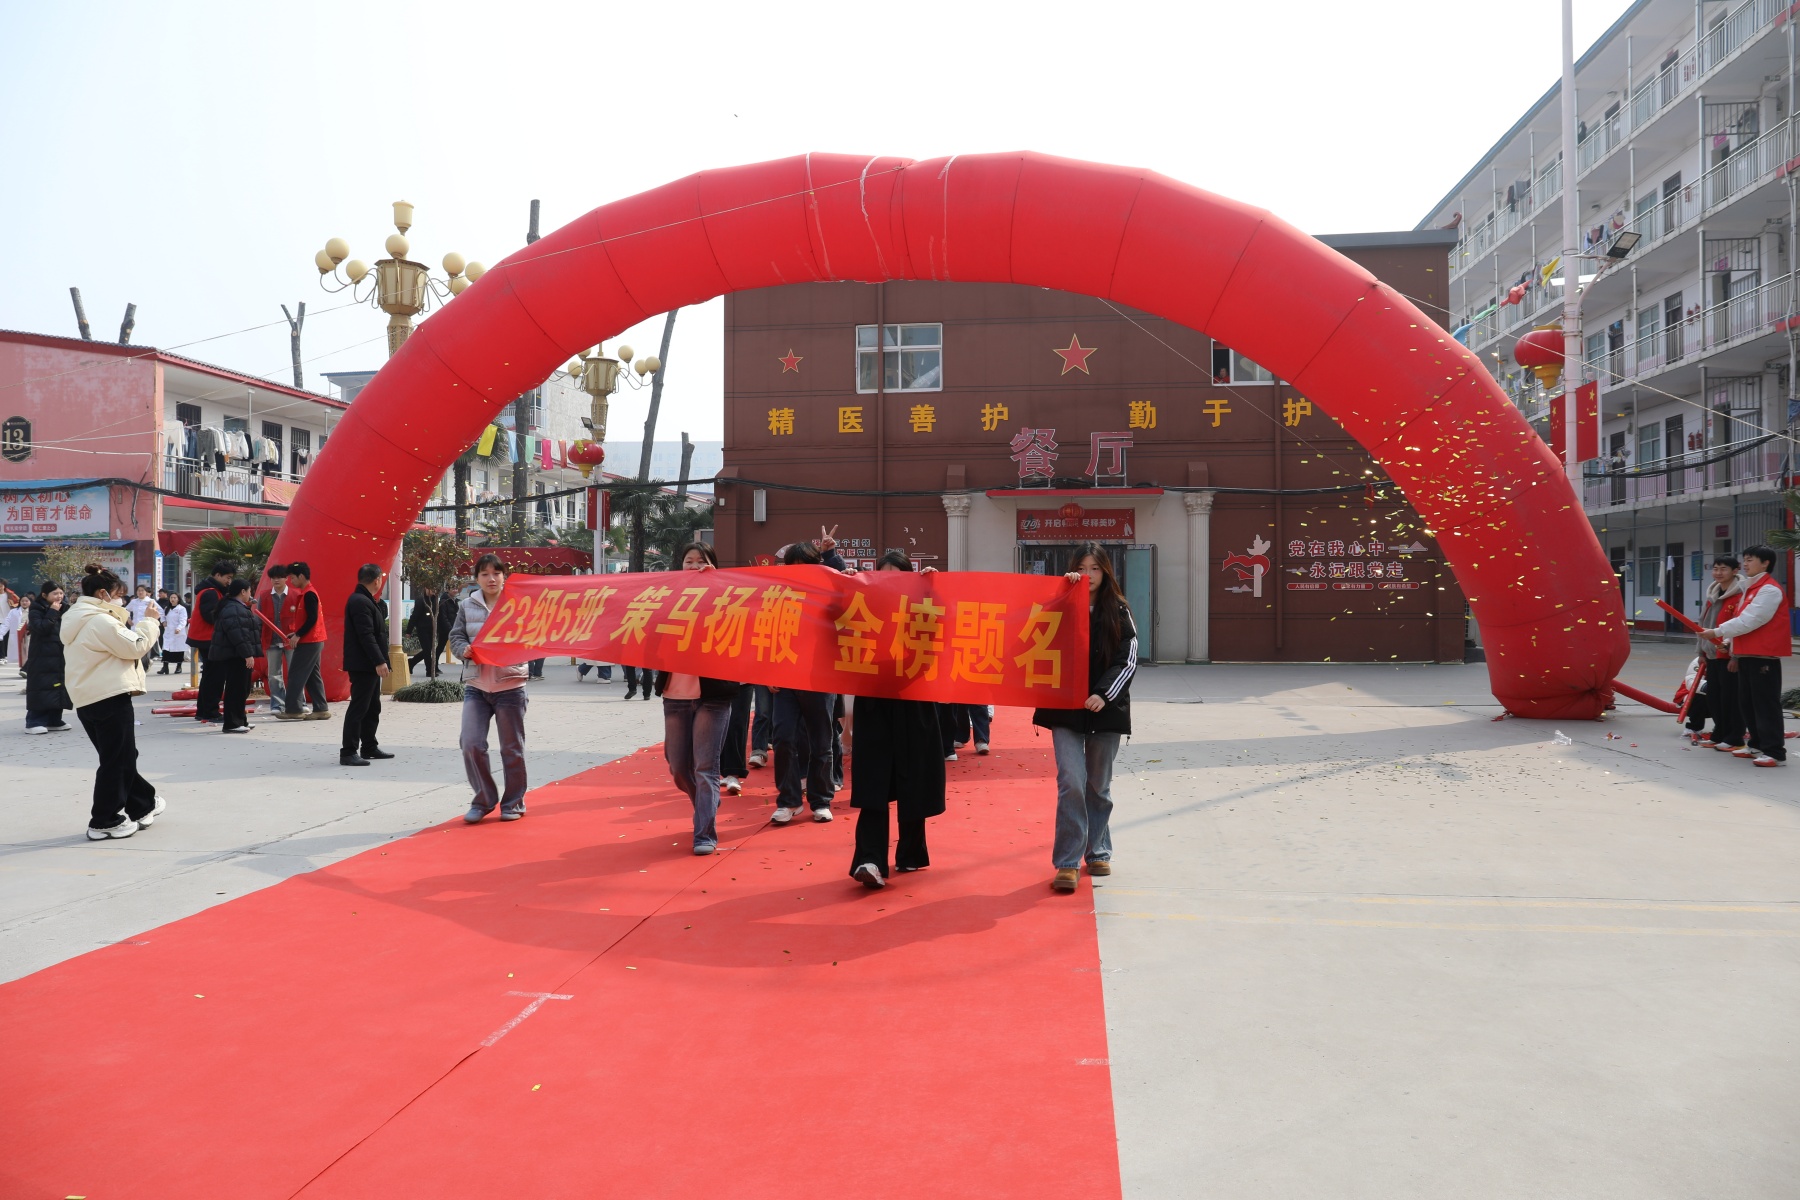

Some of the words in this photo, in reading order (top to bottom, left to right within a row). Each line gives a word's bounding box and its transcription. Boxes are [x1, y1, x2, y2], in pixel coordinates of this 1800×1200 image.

[767, 402, 1010, 436] 精医善护
[1011, 427, 1133, 479] 餐厅
[6, 504, 92, 521] 为国育才使命
[1288, 539, 1385, 557] 党在我心中
[1308, 561, 1404, 579] 永远跟党走
[482, 586, 618, 650] 23级5班
[609, 584, 807, 665] 策马扬鞭
[834, 591, 1064, 689] 金榜题名
